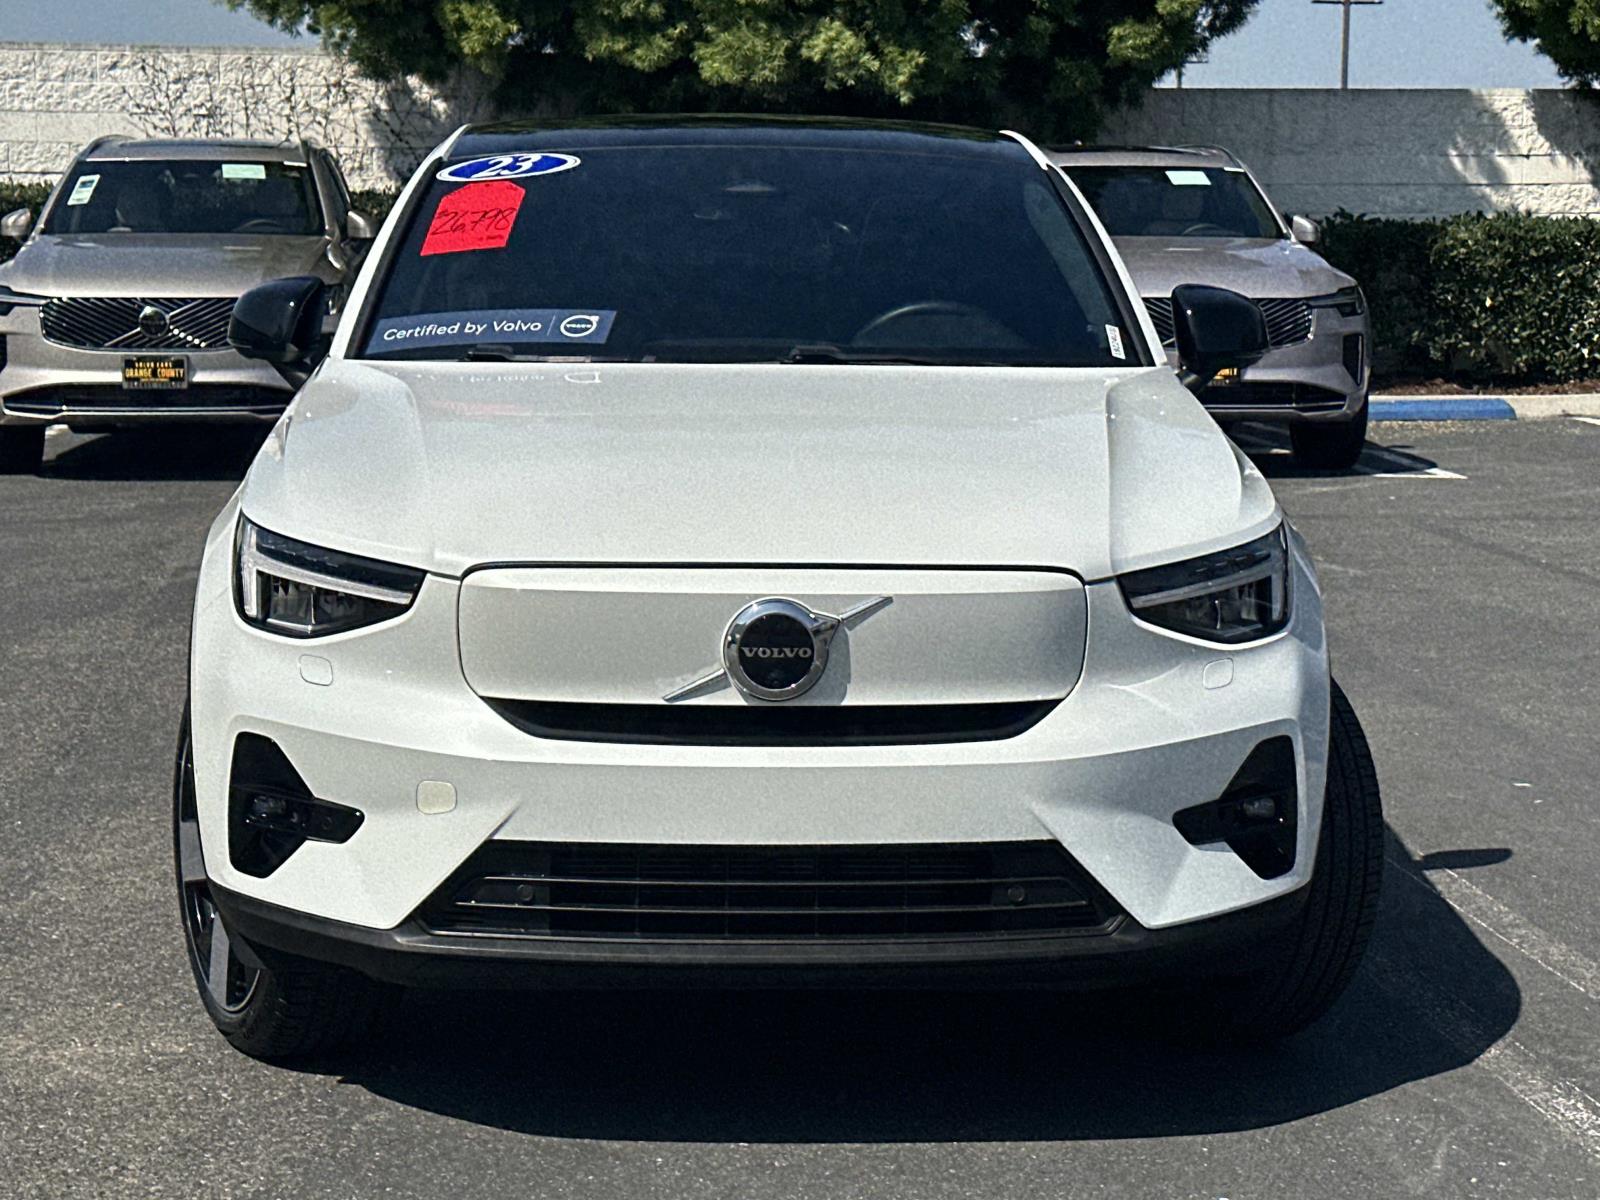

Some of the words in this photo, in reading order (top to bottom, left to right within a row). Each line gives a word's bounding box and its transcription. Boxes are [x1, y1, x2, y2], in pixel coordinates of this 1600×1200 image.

[470, 154, 542, 178] 23
[383, 321, 461, 341] Certified
[464, 321, 487, 336] by
[493, 319, 542, 332] Volvo
[125, 368, 152, 378] ORANGE
[157, 368, 184, 378] COUNTY
[741, 646, 812, 658] VOLVO
